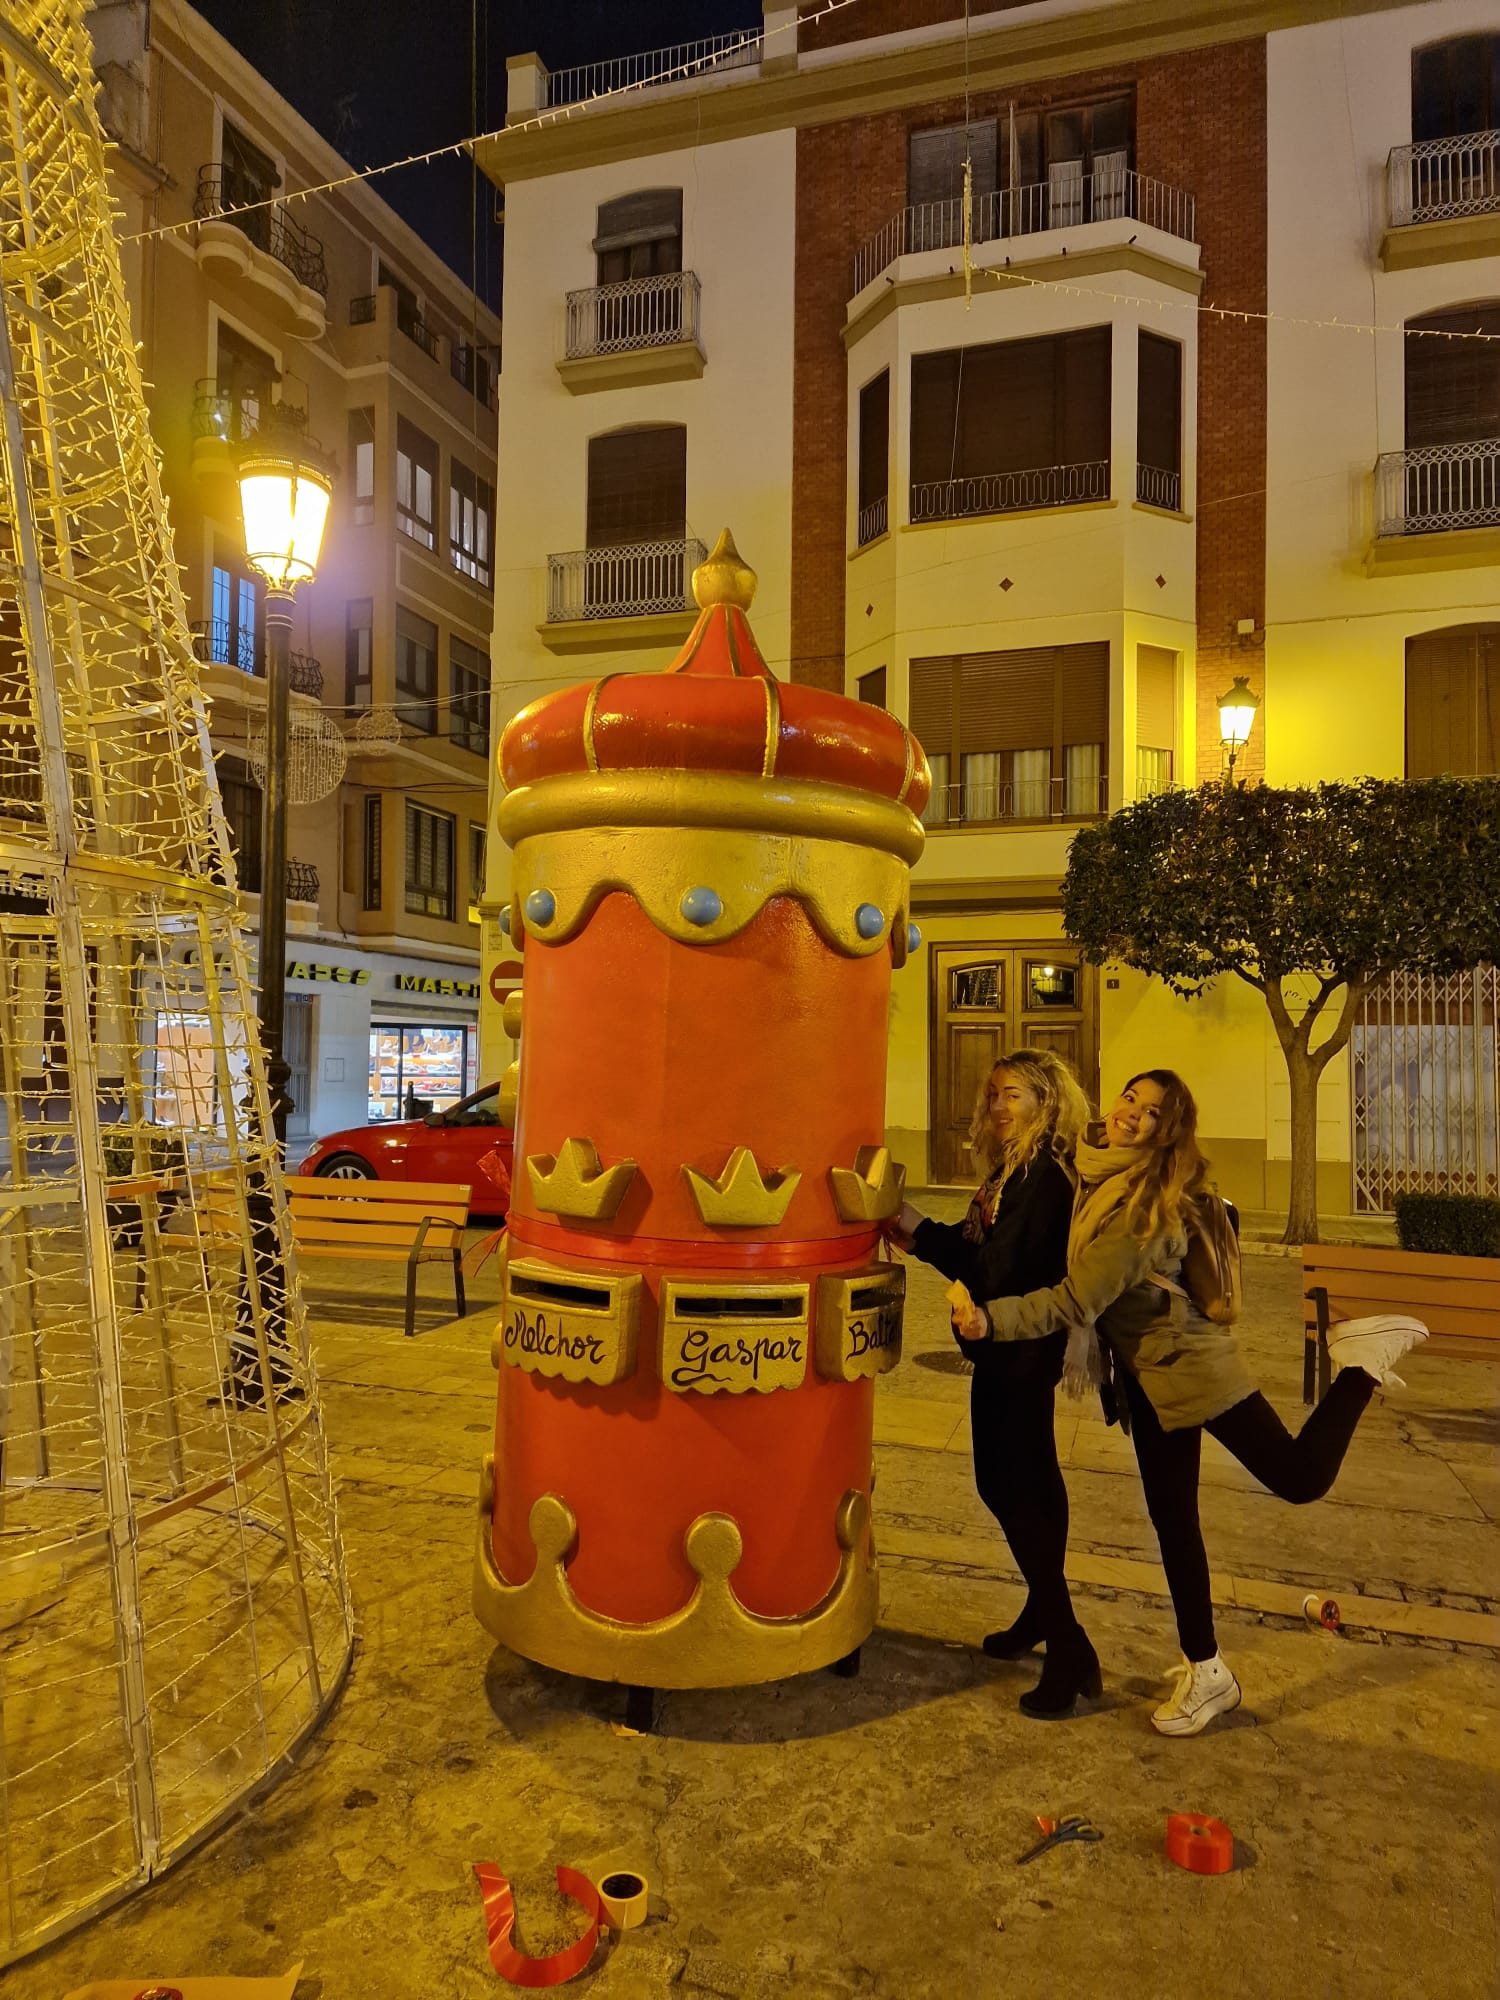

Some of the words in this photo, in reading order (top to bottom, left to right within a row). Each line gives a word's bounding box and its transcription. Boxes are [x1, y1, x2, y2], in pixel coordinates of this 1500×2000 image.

[396, 975, 480, 998] MARTI
[504, 1310, 606, 1365] Melchor
[671, 1328, 803, 1386] Gaspar
